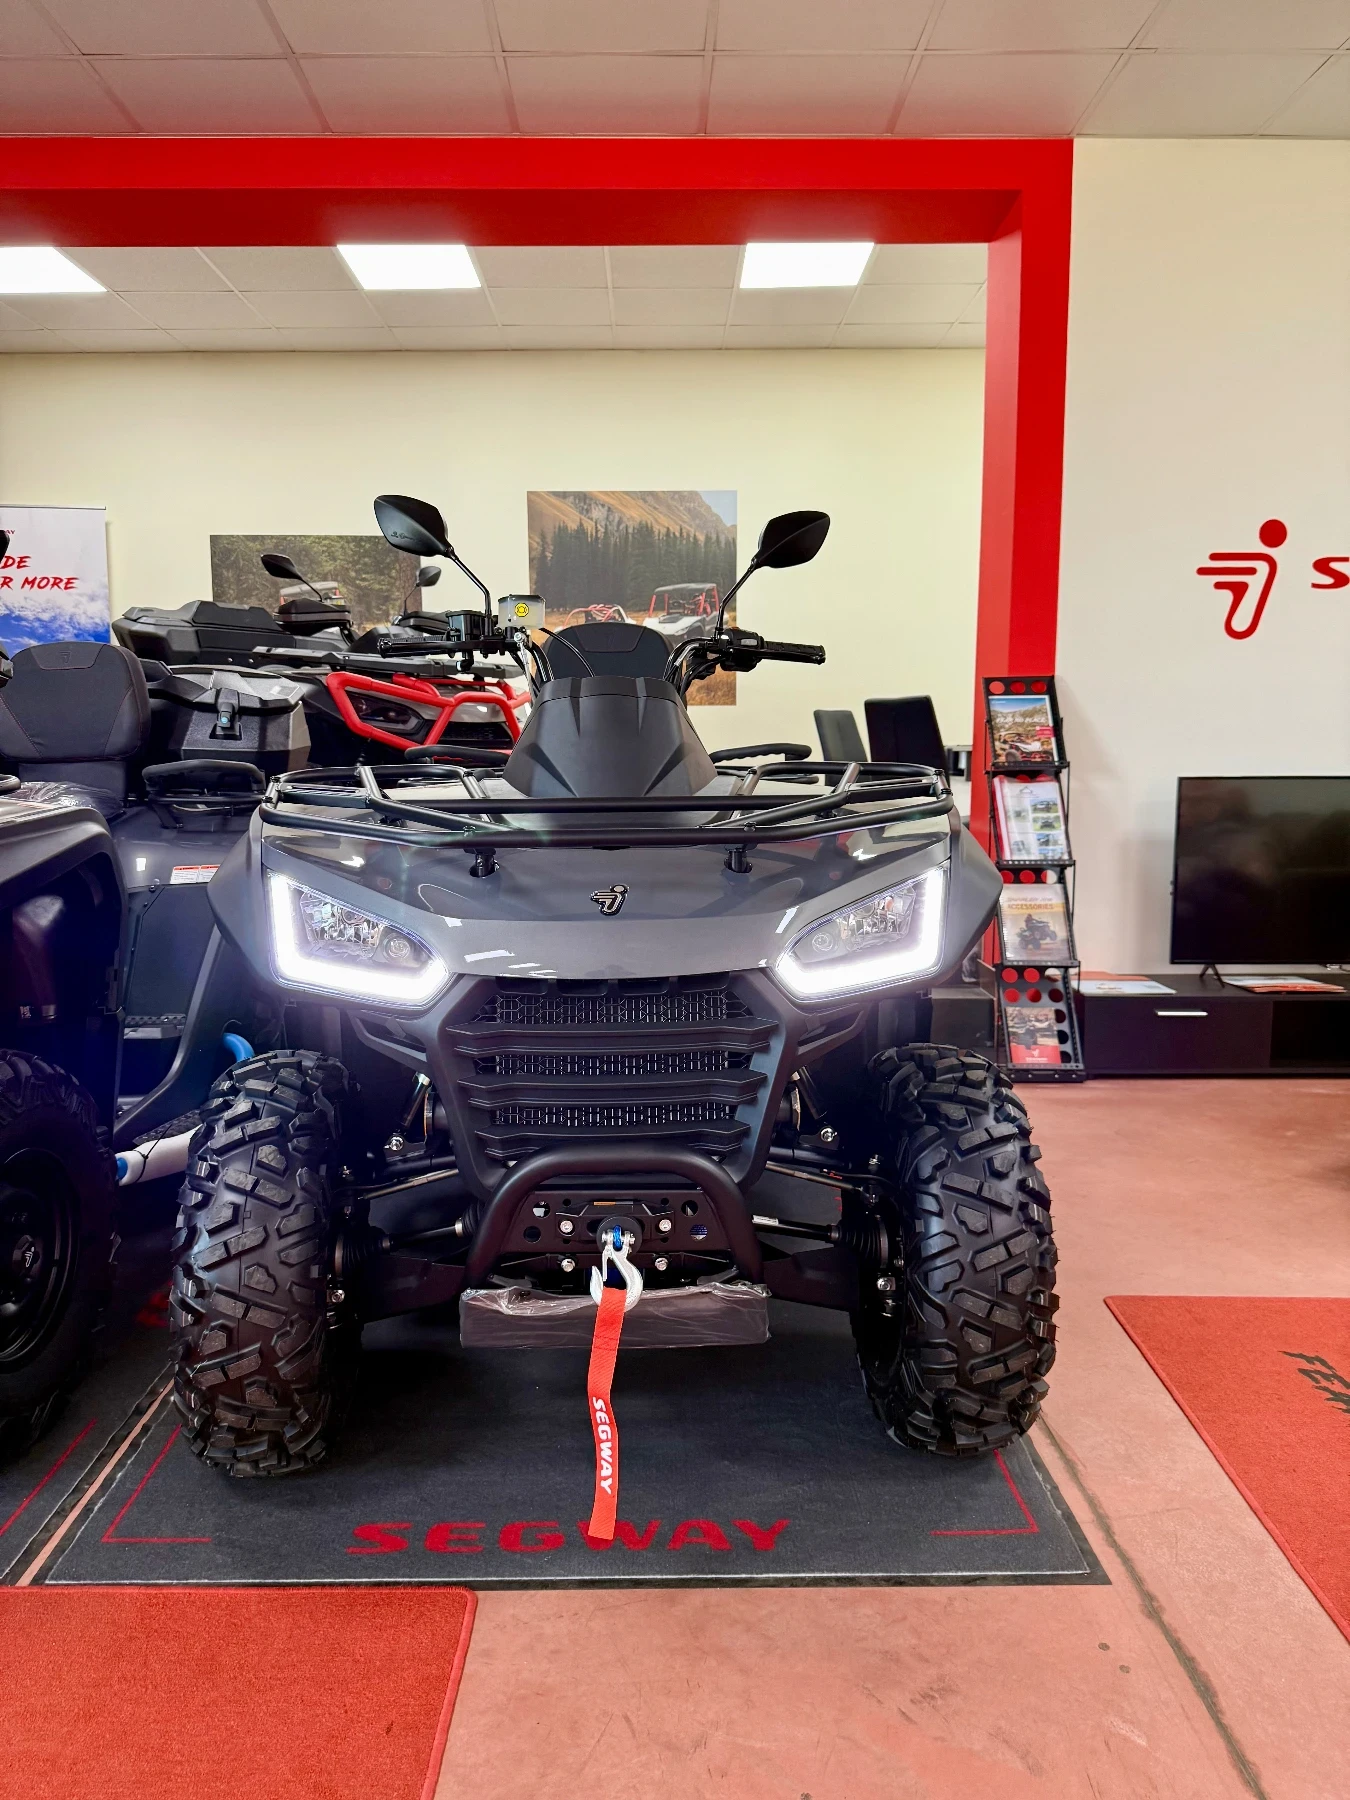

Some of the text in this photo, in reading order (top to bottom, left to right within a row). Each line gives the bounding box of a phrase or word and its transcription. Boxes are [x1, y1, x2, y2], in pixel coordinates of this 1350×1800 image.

[20, 576, 78, 590] MORE
[592, 1396, 613, 1495] SEGWAY
[345, 1519, 790, 1554] SEGWAY
